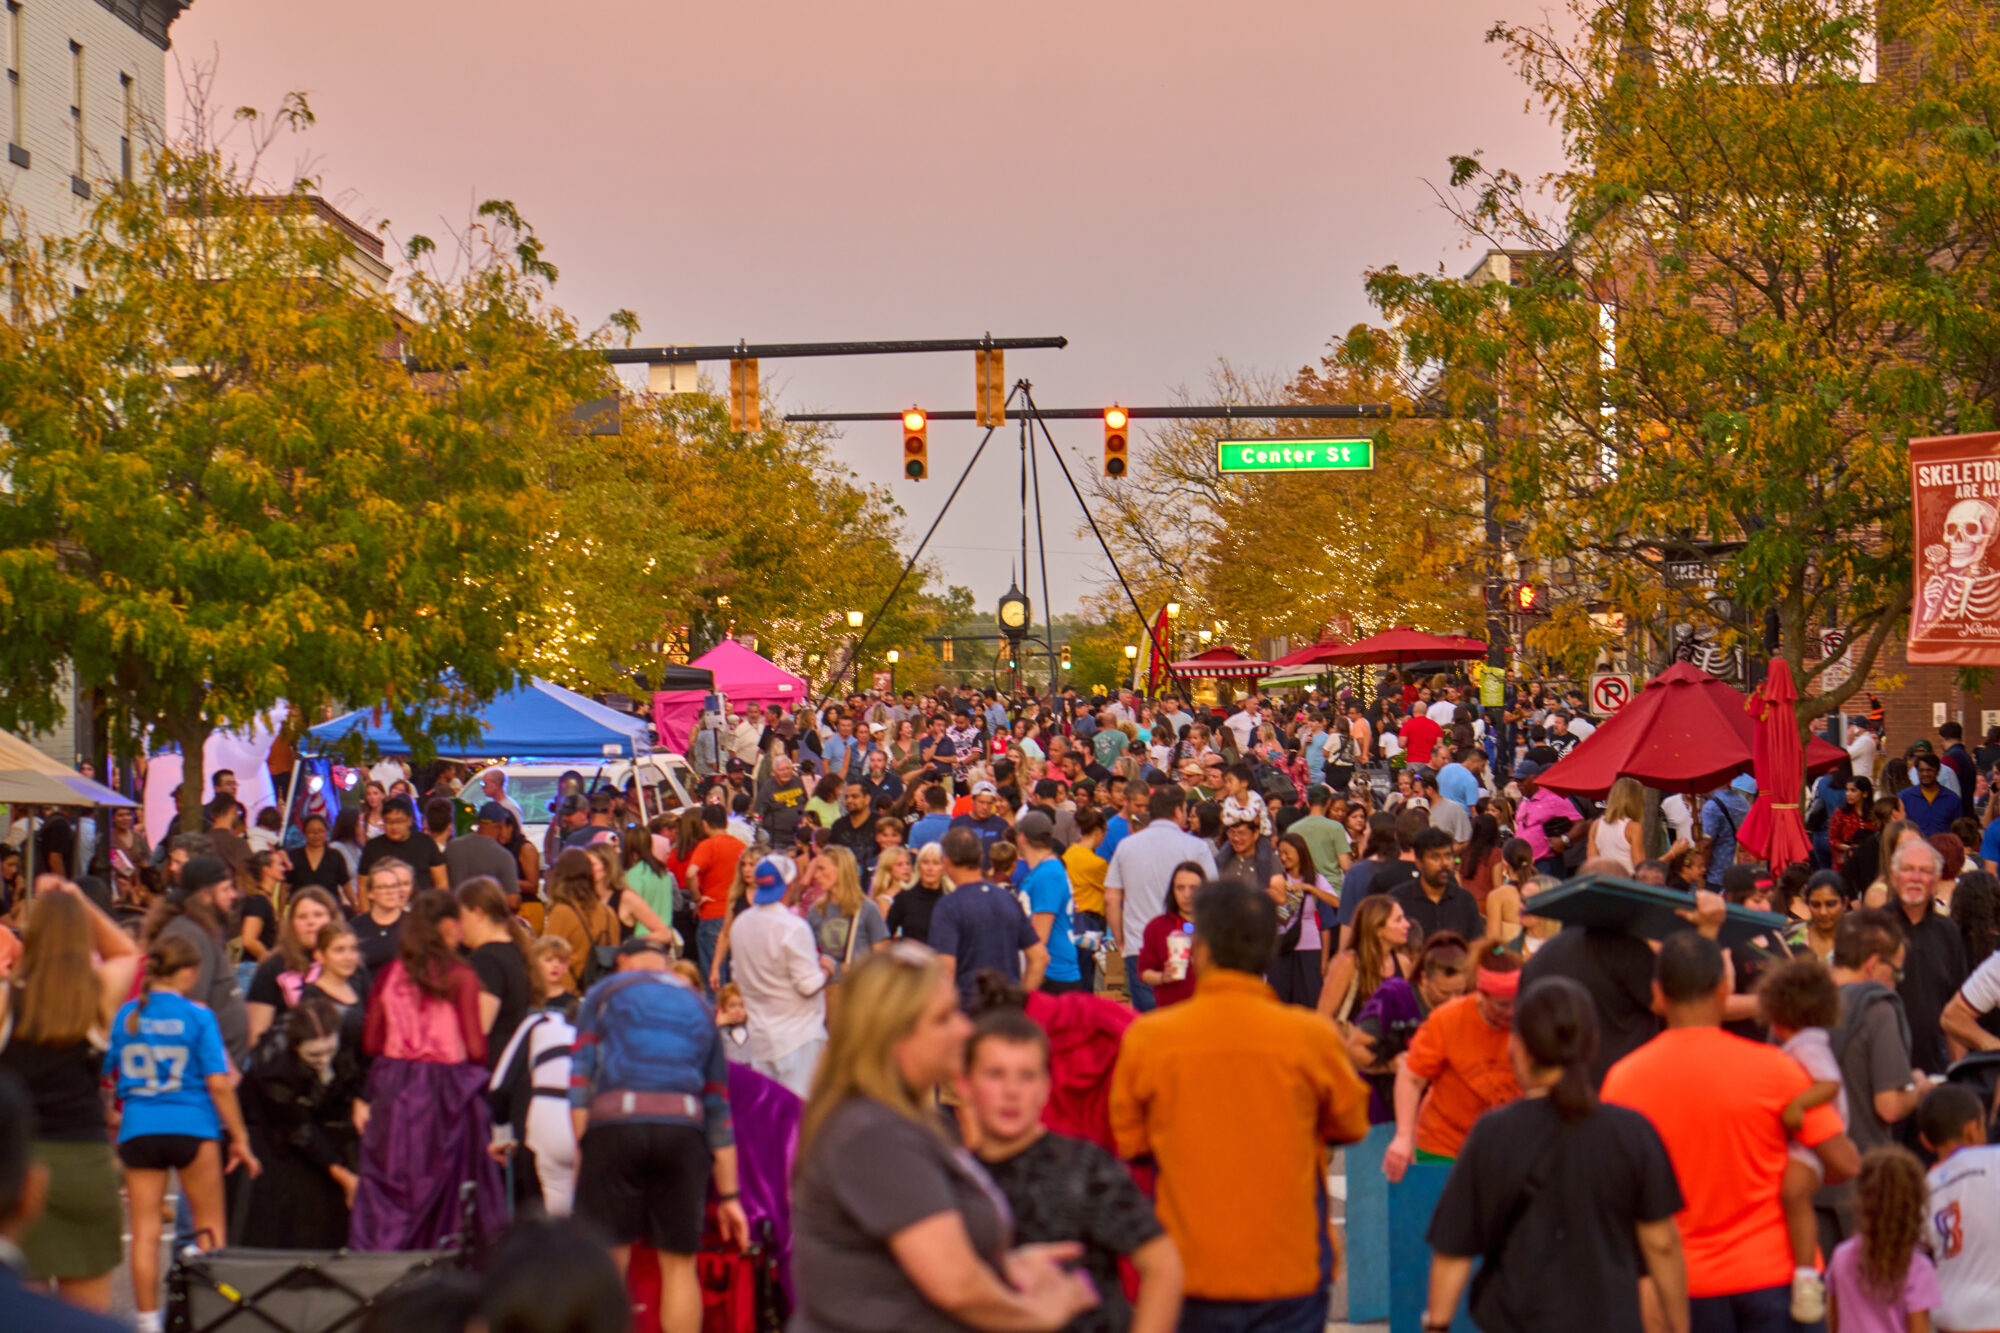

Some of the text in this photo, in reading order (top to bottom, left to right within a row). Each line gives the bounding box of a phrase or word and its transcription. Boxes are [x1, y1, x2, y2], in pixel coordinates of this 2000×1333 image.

[1240, 446, 1350, 464] Center St
[1955, 481, 2000, 499] ARE AL
[1957, 621, 2000, 637] North
[120, 1043, 189, 1096] 97
